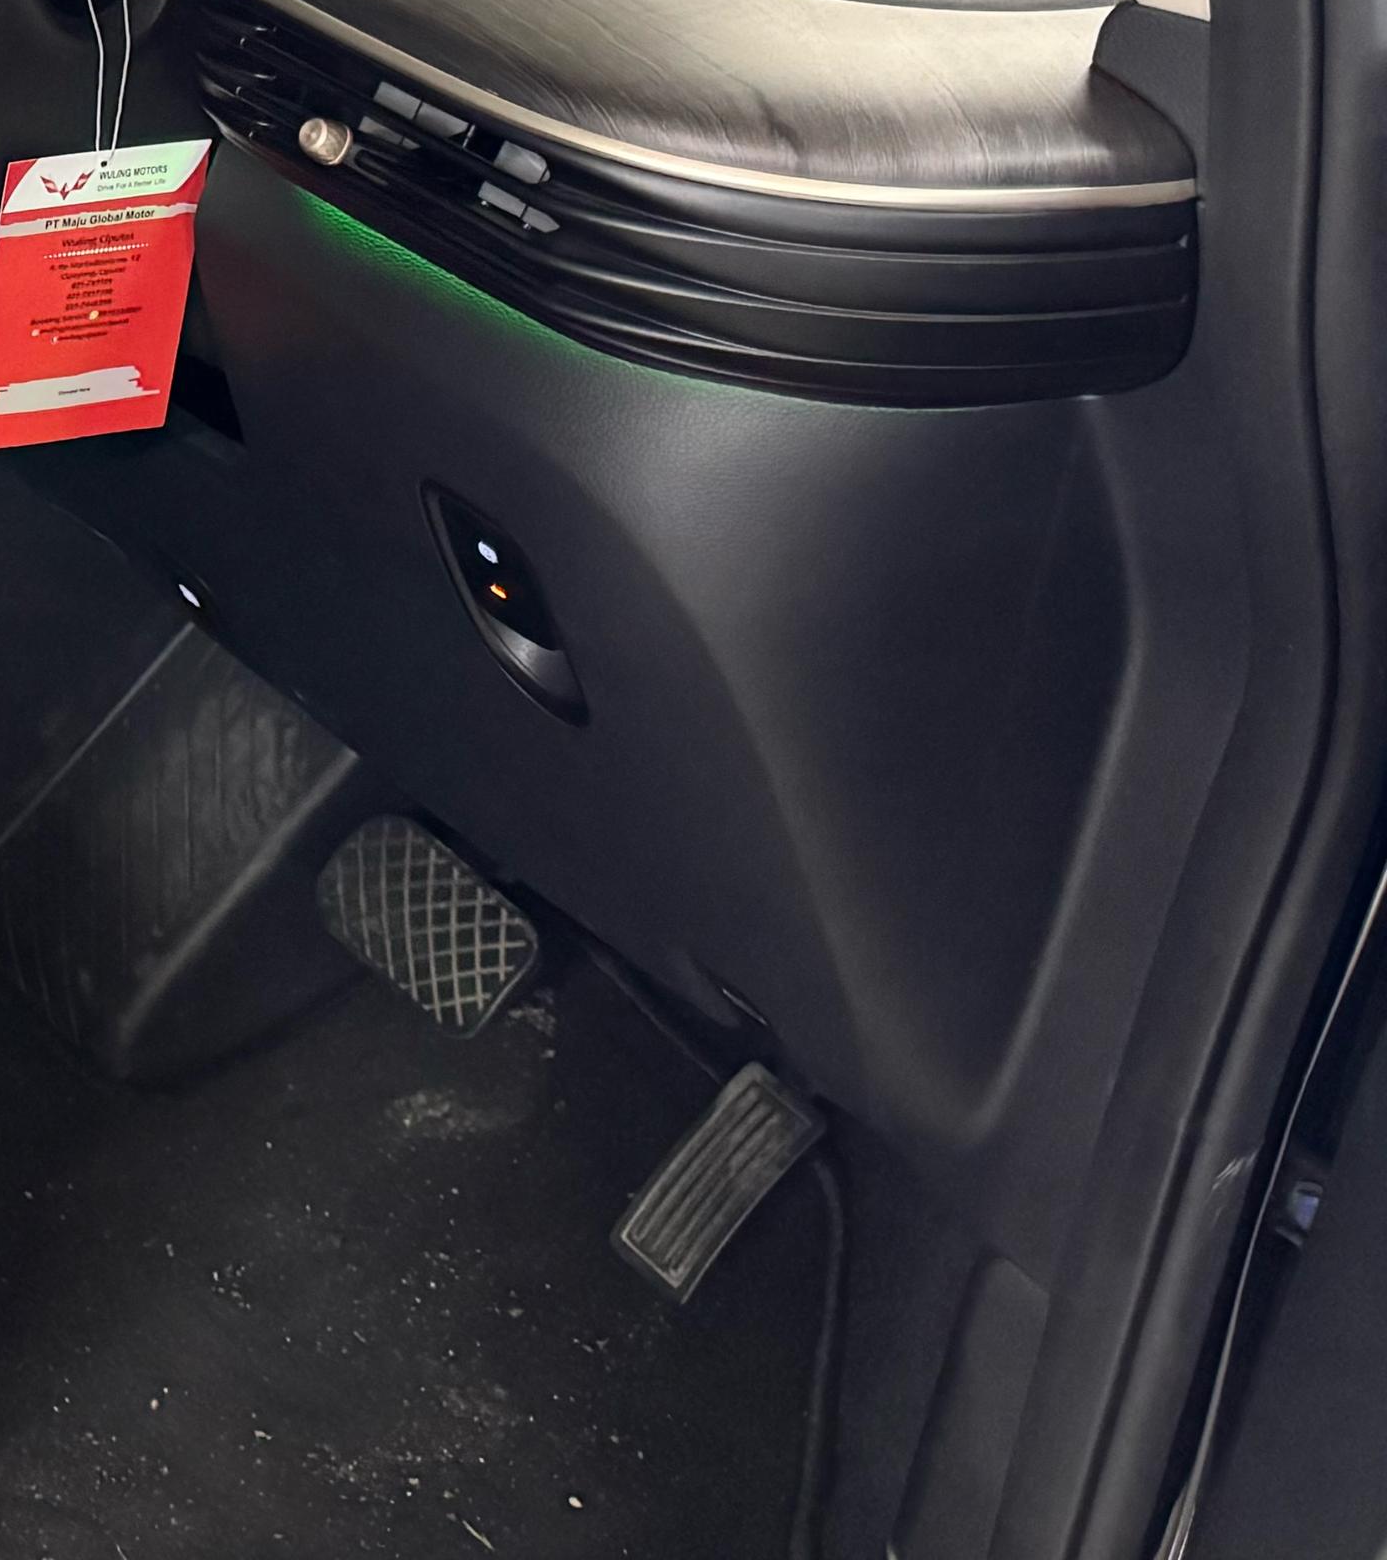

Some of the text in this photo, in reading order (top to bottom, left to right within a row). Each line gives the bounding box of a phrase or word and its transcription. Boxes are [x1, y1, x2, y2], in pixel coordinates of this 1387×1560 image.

[99, 164, 168, 181] WULING MOTORS
[97, 184, 114, 192] Drive
[115, 182, 126, 190] For
[45, 209, 155, 230] PT Maju Global Motor
